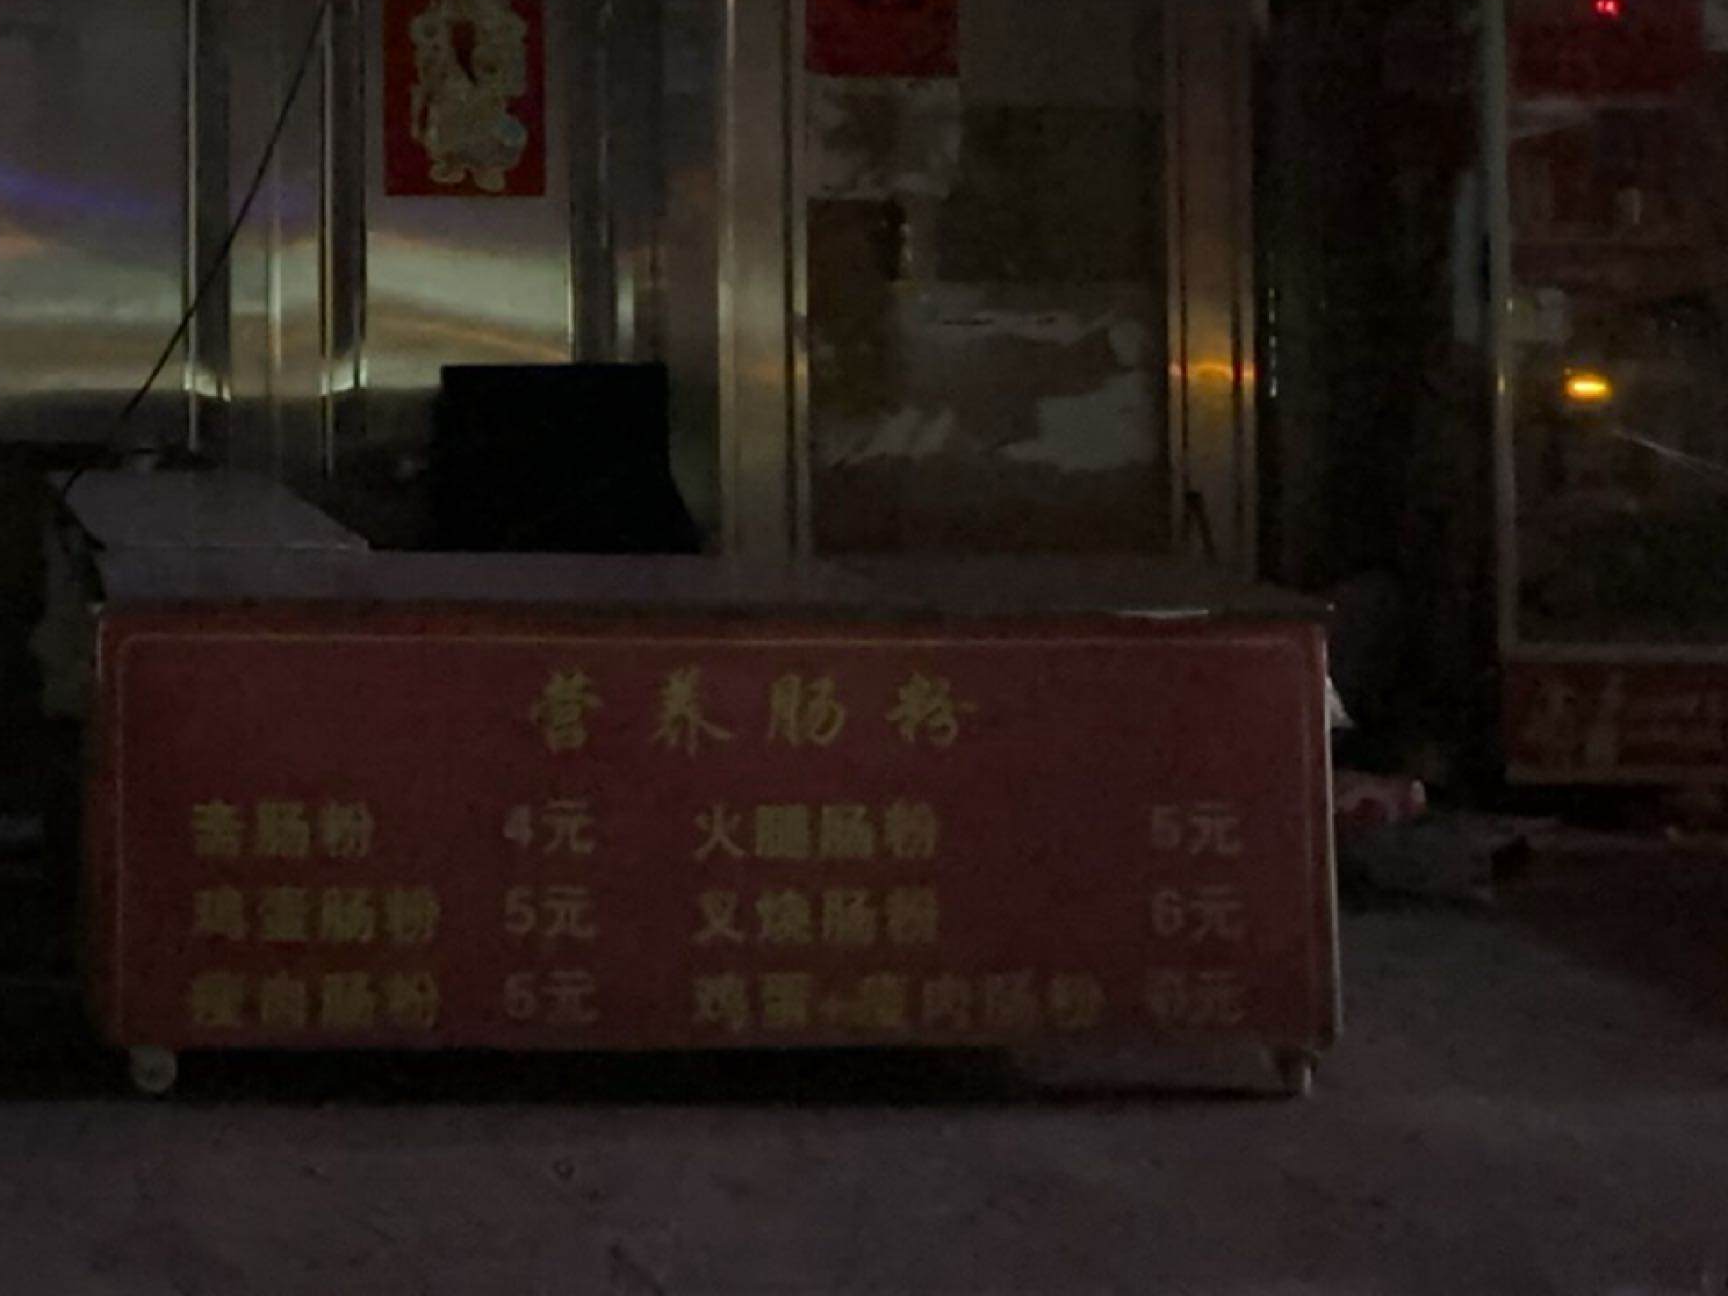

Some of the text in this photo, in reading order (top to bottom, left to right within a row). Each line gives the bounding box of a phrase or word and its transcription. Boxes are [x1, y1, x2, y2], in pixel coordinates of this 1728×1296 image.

[528, 662, 978, 759] 营养肠粉
[502, 798, 598, 856] 4元
[503, 885, 599, 940] 5元
[1149, 884, 1246, 943] 6元
